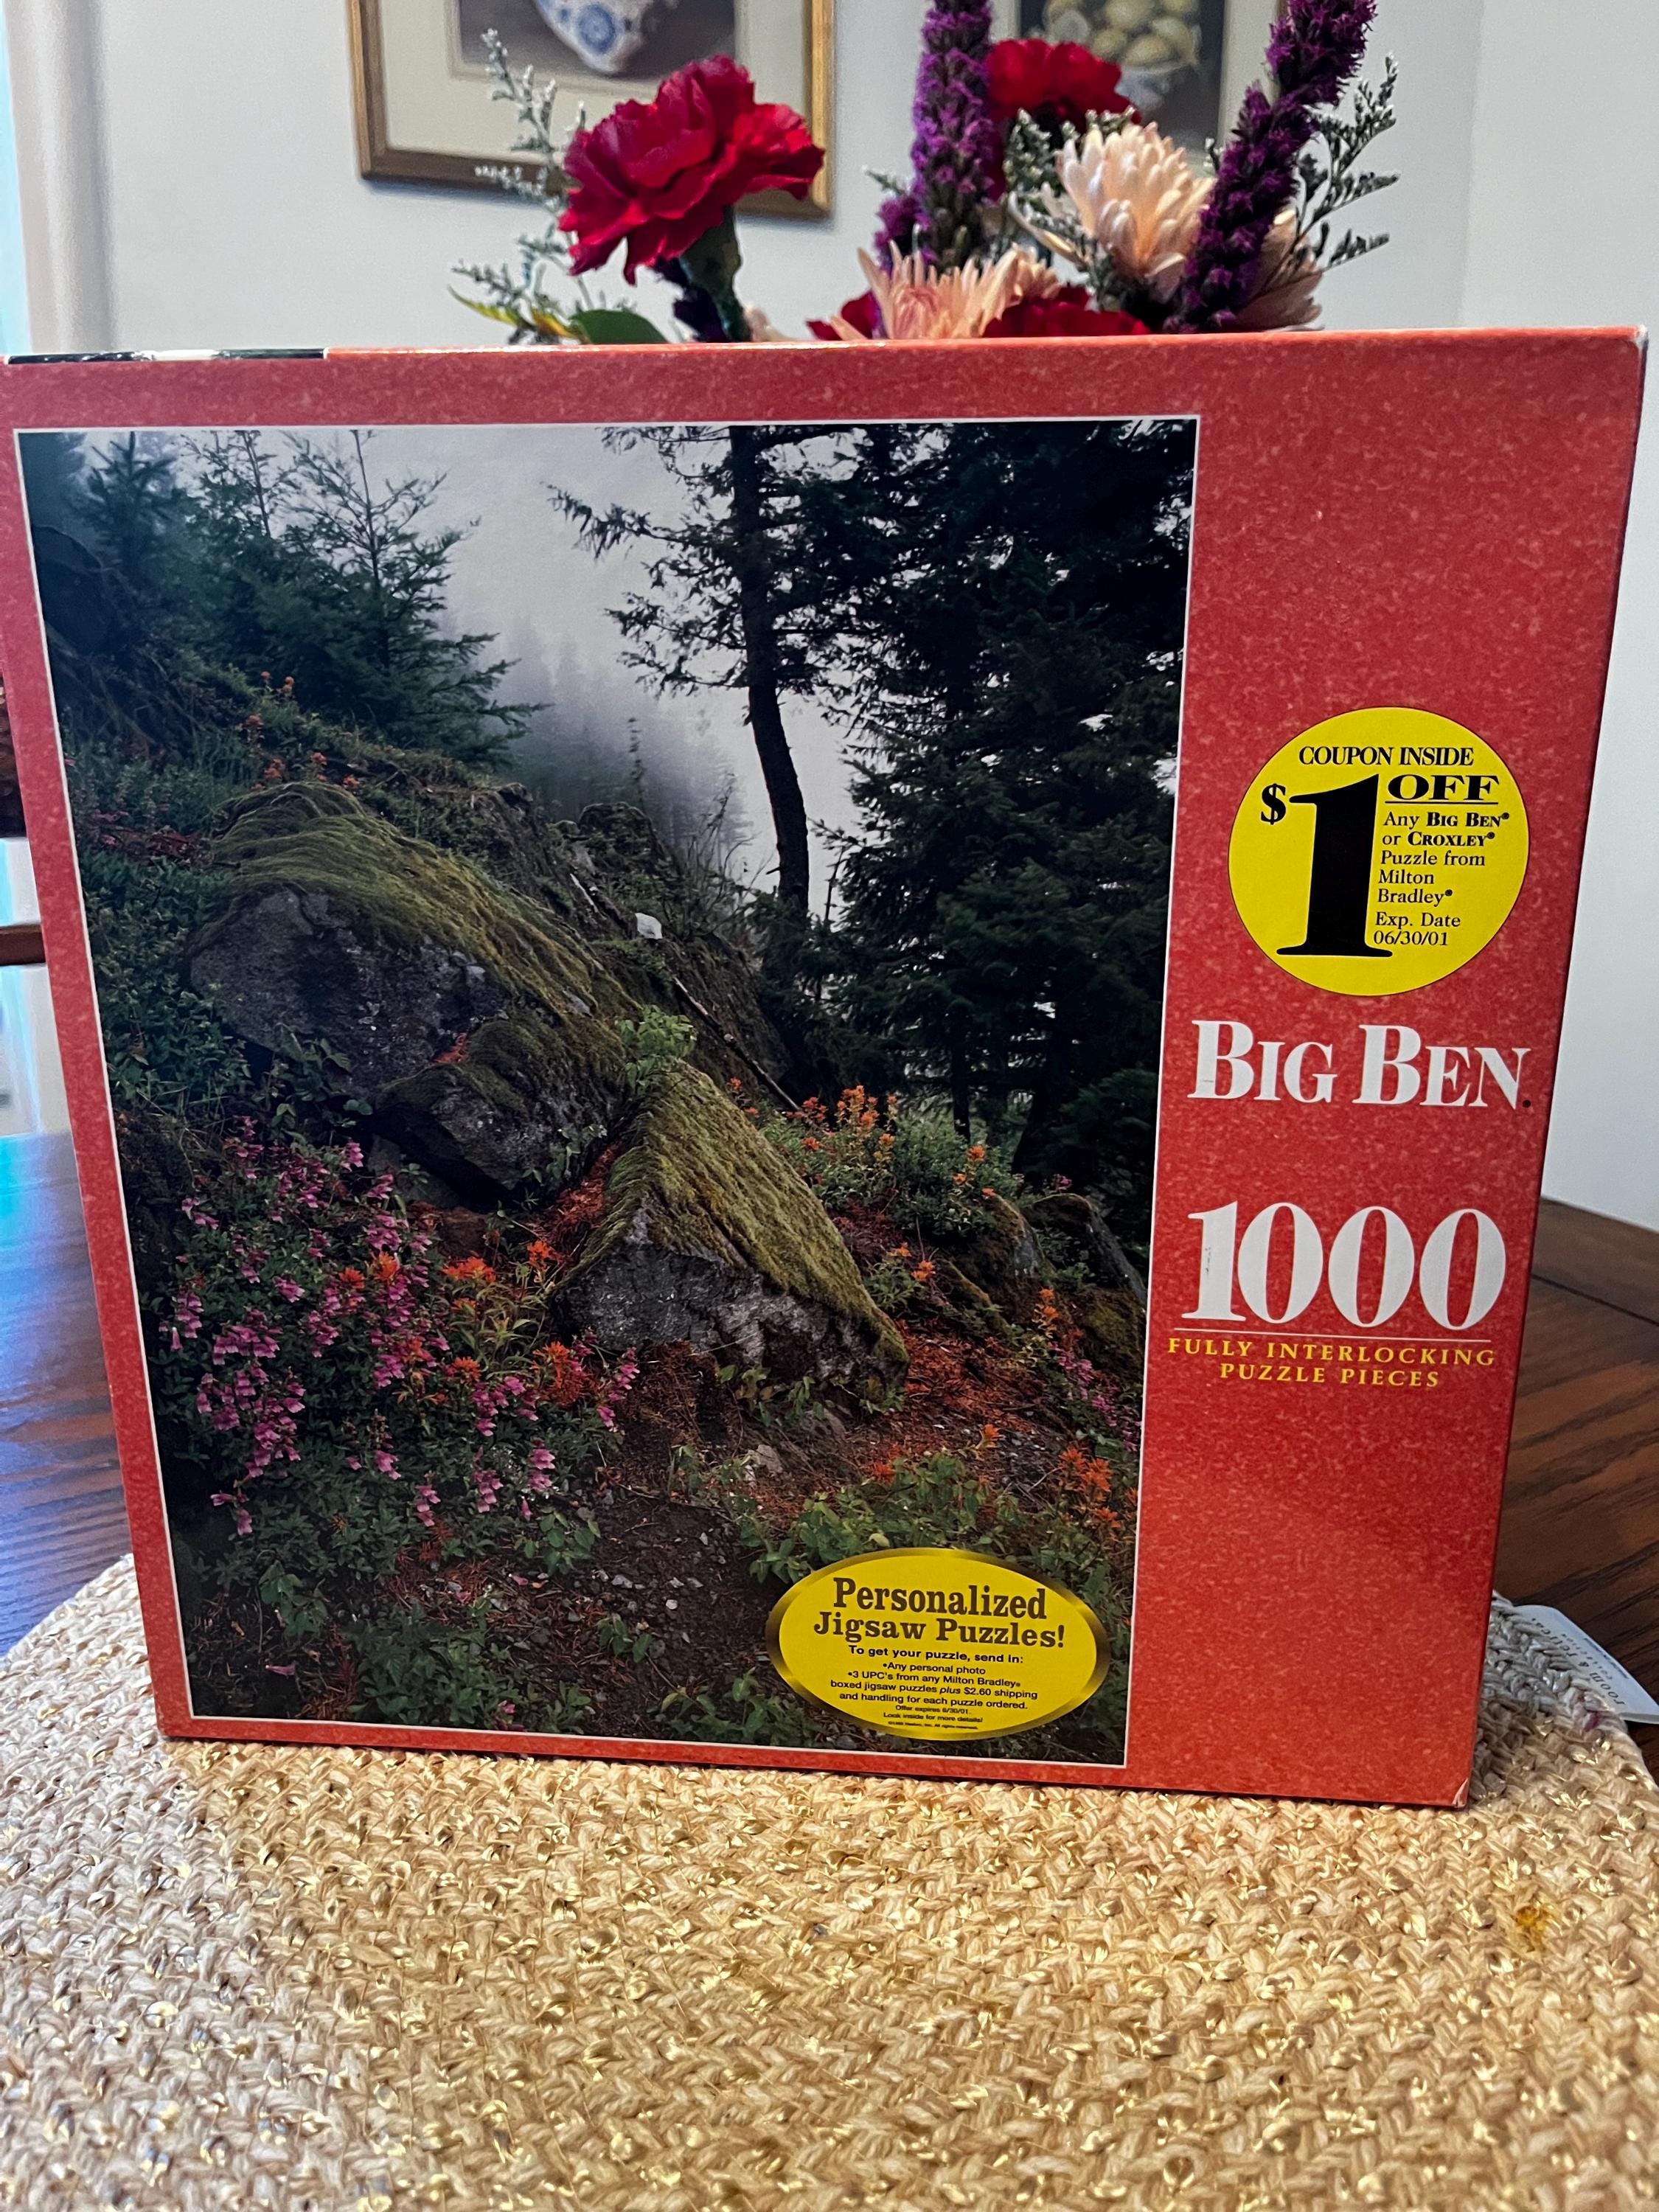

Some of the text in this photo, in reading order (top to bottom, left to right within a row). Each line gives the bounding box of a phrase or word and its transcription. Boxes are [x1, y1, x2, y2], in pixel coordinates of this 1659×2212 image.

[1298, 746, 1474, 766] COUPON INSIDE
[1387, 774, 1499, 801] OFF
[1383, 812, 1419, 830] Any
[1427, 813, 1458, 827] BIG
[1382, 835, 1400, 846] or
[1380, 850, 1485, 866] Puzzle from
[1378, 870, 1434, 884] Milton
[1375, 912, 1460, 929] Exp. Date
[1374, 931, 1448, 946] 06/30/01
[1187, 1020, 1338, 1103] BIG
[1181, 1200, 1506, 1331] 1000
[1168, 1338, 1495, 1366] FULLY INTERLOCKING
[1220, 1364, 1439, 1388] PUZZLE PIECES
[833, 1577, 1046, 1619] Personalized
[813, 1611, 1065, 1648] Jigsaw Puzzles!
[849, 1645, 864, 1654] To
[869, 1648, 888, 1657] get
[893, 1649, 921, 1658] your
[925, 1652, 970, 1661] puzzle,
[1009, 1655, 1023, 1663] in:
[862, 1672, 893, 1680] UPC's
[922, 1675, 939, 1683] any
[943, 1675, 973, 1684] Milton
[910, 1664, 953, 1673] personal
[956, 1666, 986, 1674] photo
[830, 1680, 861, 1688] boxed
[864, 1683, 896, 1691] jigsaw
[939, 1686, 961, 1694] plus
[964, 1687, 991, 1695] $2.60
[995, 1689, 1038, 1700] shipping
[1590, 1673, 1626, 1705] room
[861, 1694, 903, 1703] handling
[950, 1699, 983, 1707] puzzle
[986, 1701, 1028, 1709] ordered.
